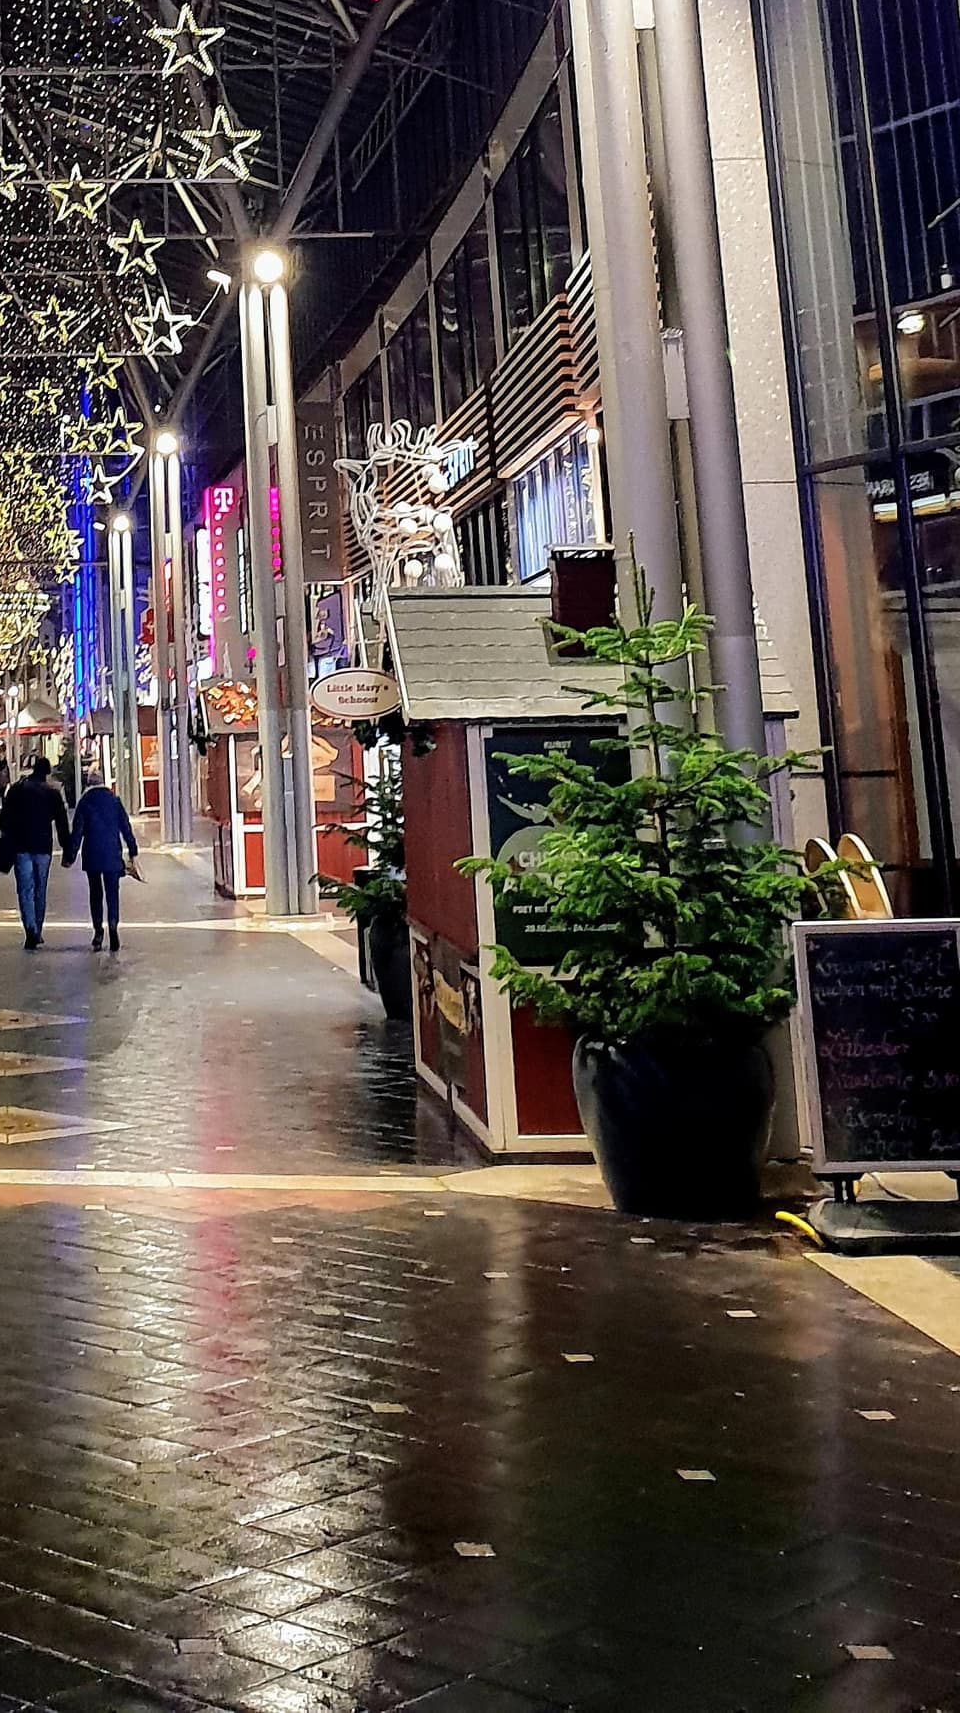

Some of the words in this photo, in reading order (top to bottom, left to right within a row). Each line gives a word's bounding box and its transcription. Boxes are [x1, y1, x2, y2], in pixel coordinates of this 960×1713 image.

[213, 487, 234, 513] T
[303, 423, 331, 560] ESPRIT
[327, 684, 353, 693] Little
[356, 684, 389, 693] Mary's
